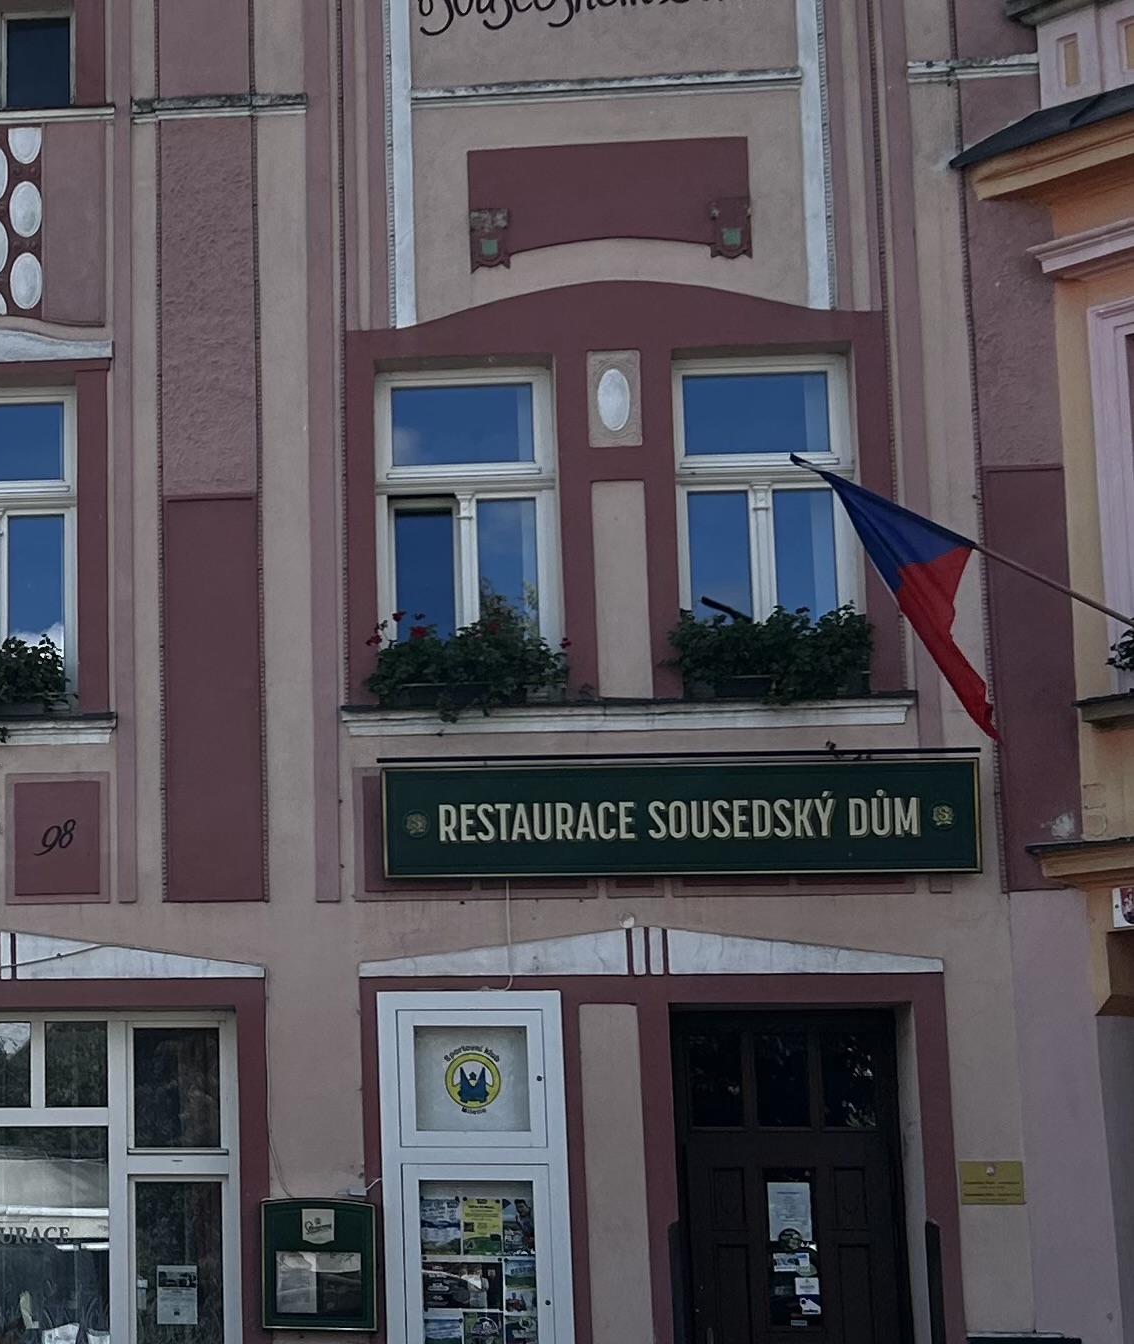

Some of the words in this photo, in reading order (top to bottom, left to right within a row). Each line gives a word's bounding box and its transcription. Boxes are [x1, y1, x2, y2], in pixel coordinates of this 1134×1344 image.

[34, 819, 76, 856] 98
[438, 800, 637, 842] RESTAURACE
[648, 790, 835, 840] SOUSEDSKÝ
[848, 788, 921, 838] DŮM
